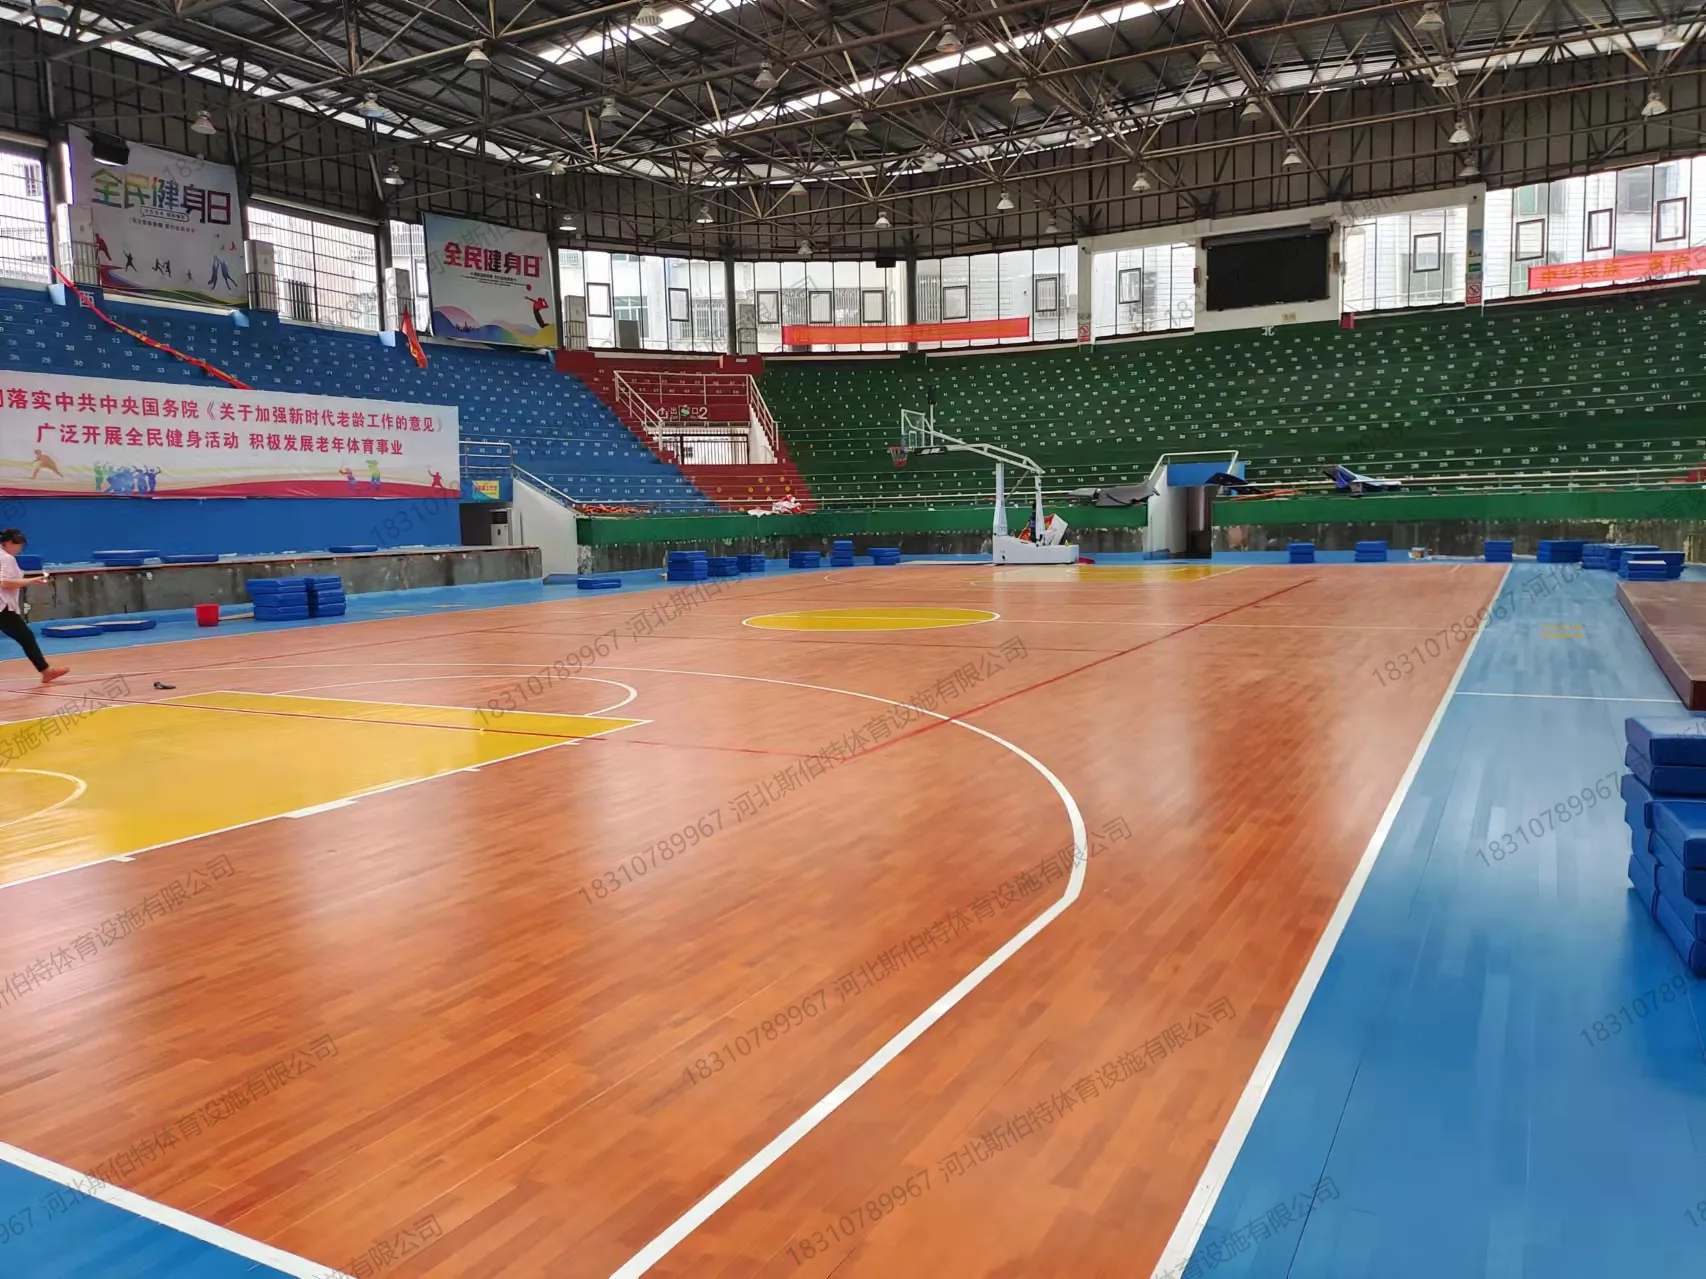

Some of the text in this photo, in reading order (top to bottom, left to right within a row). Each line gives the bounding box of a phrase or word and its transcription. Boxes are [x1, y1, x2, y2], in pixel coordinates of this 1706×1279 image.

[91, 168, 231, 225] 全民健身日
[443, 241, 540, 278] 全民健身日
[1261, 325, 1275, 337] 北
[699, 406, 708, 420] 2
[37, 423, 404, 456] 广泛开展全民健身活动 积极发展老年体育事业
